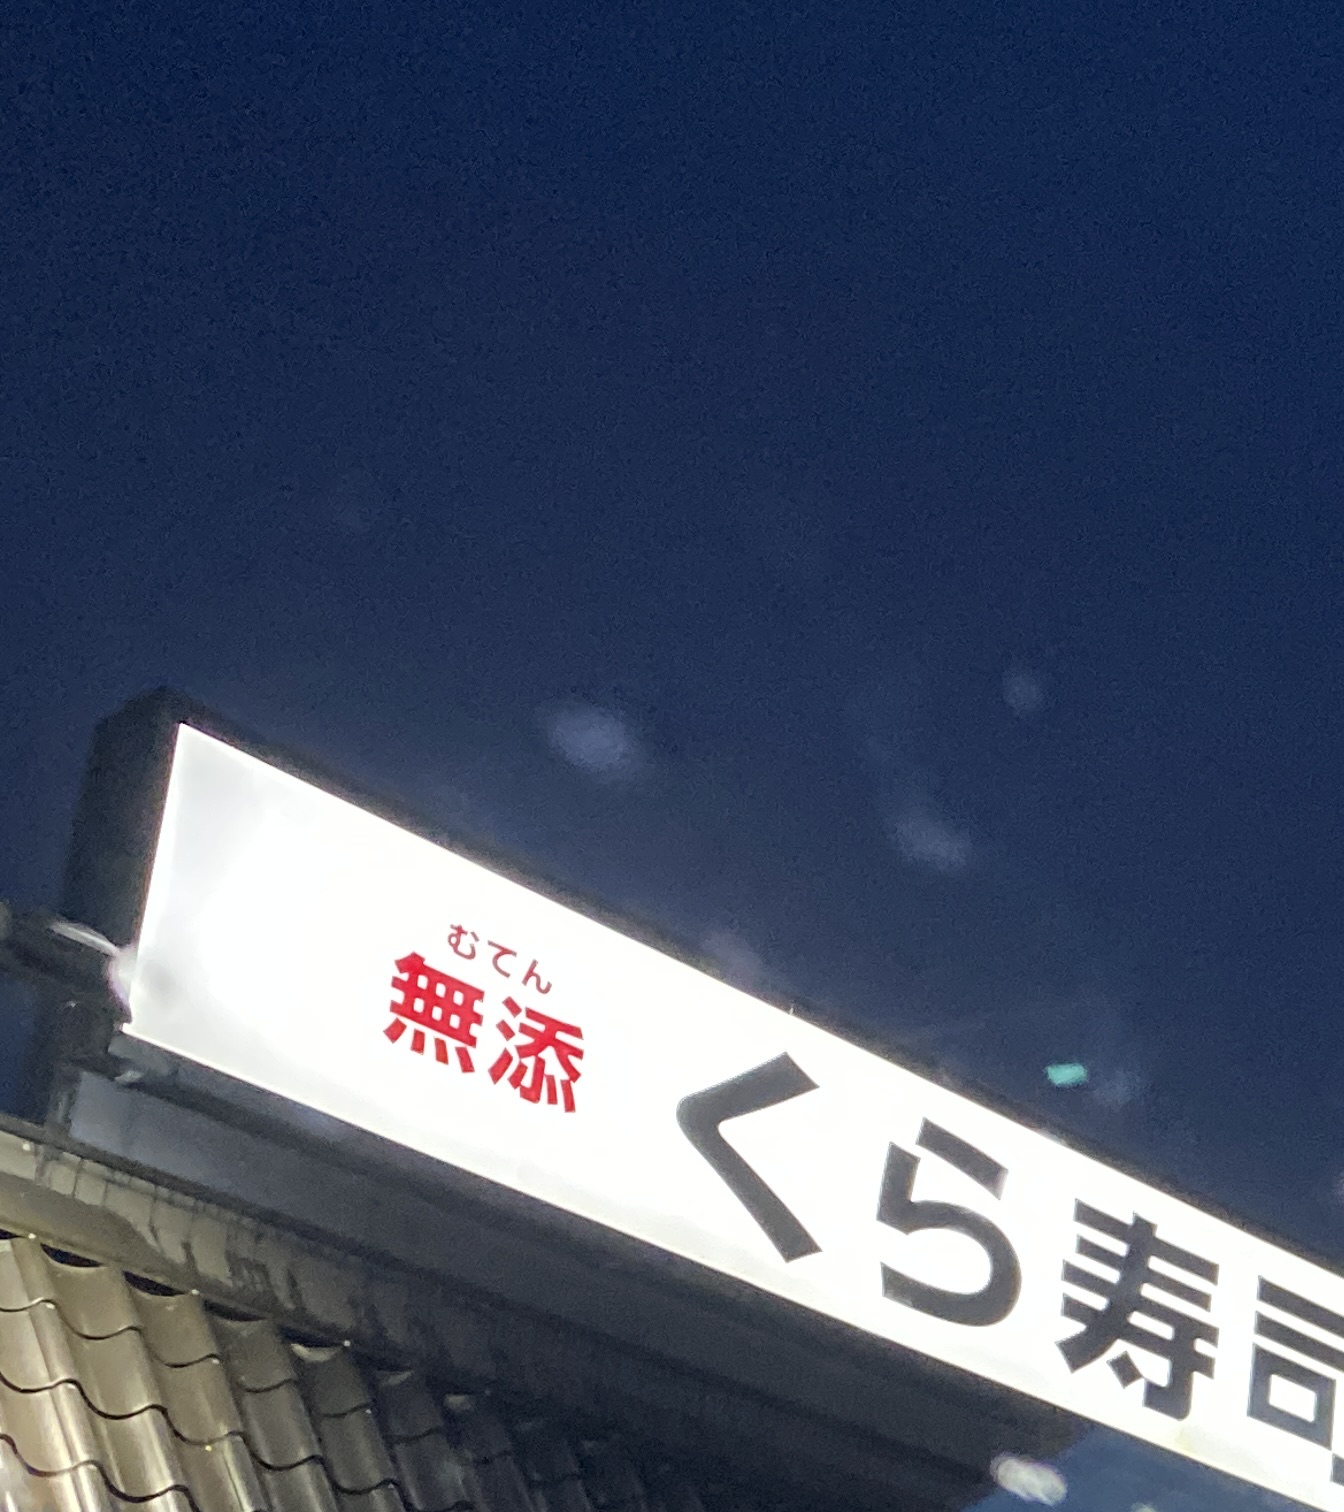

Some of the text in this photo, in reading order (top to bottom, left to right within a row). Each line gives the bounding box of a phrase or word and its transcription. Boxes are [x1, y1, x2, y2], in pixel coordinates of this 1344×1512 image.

[446, 923, 553, 995] むてん
[382, 951, 586, 1114] 無添
